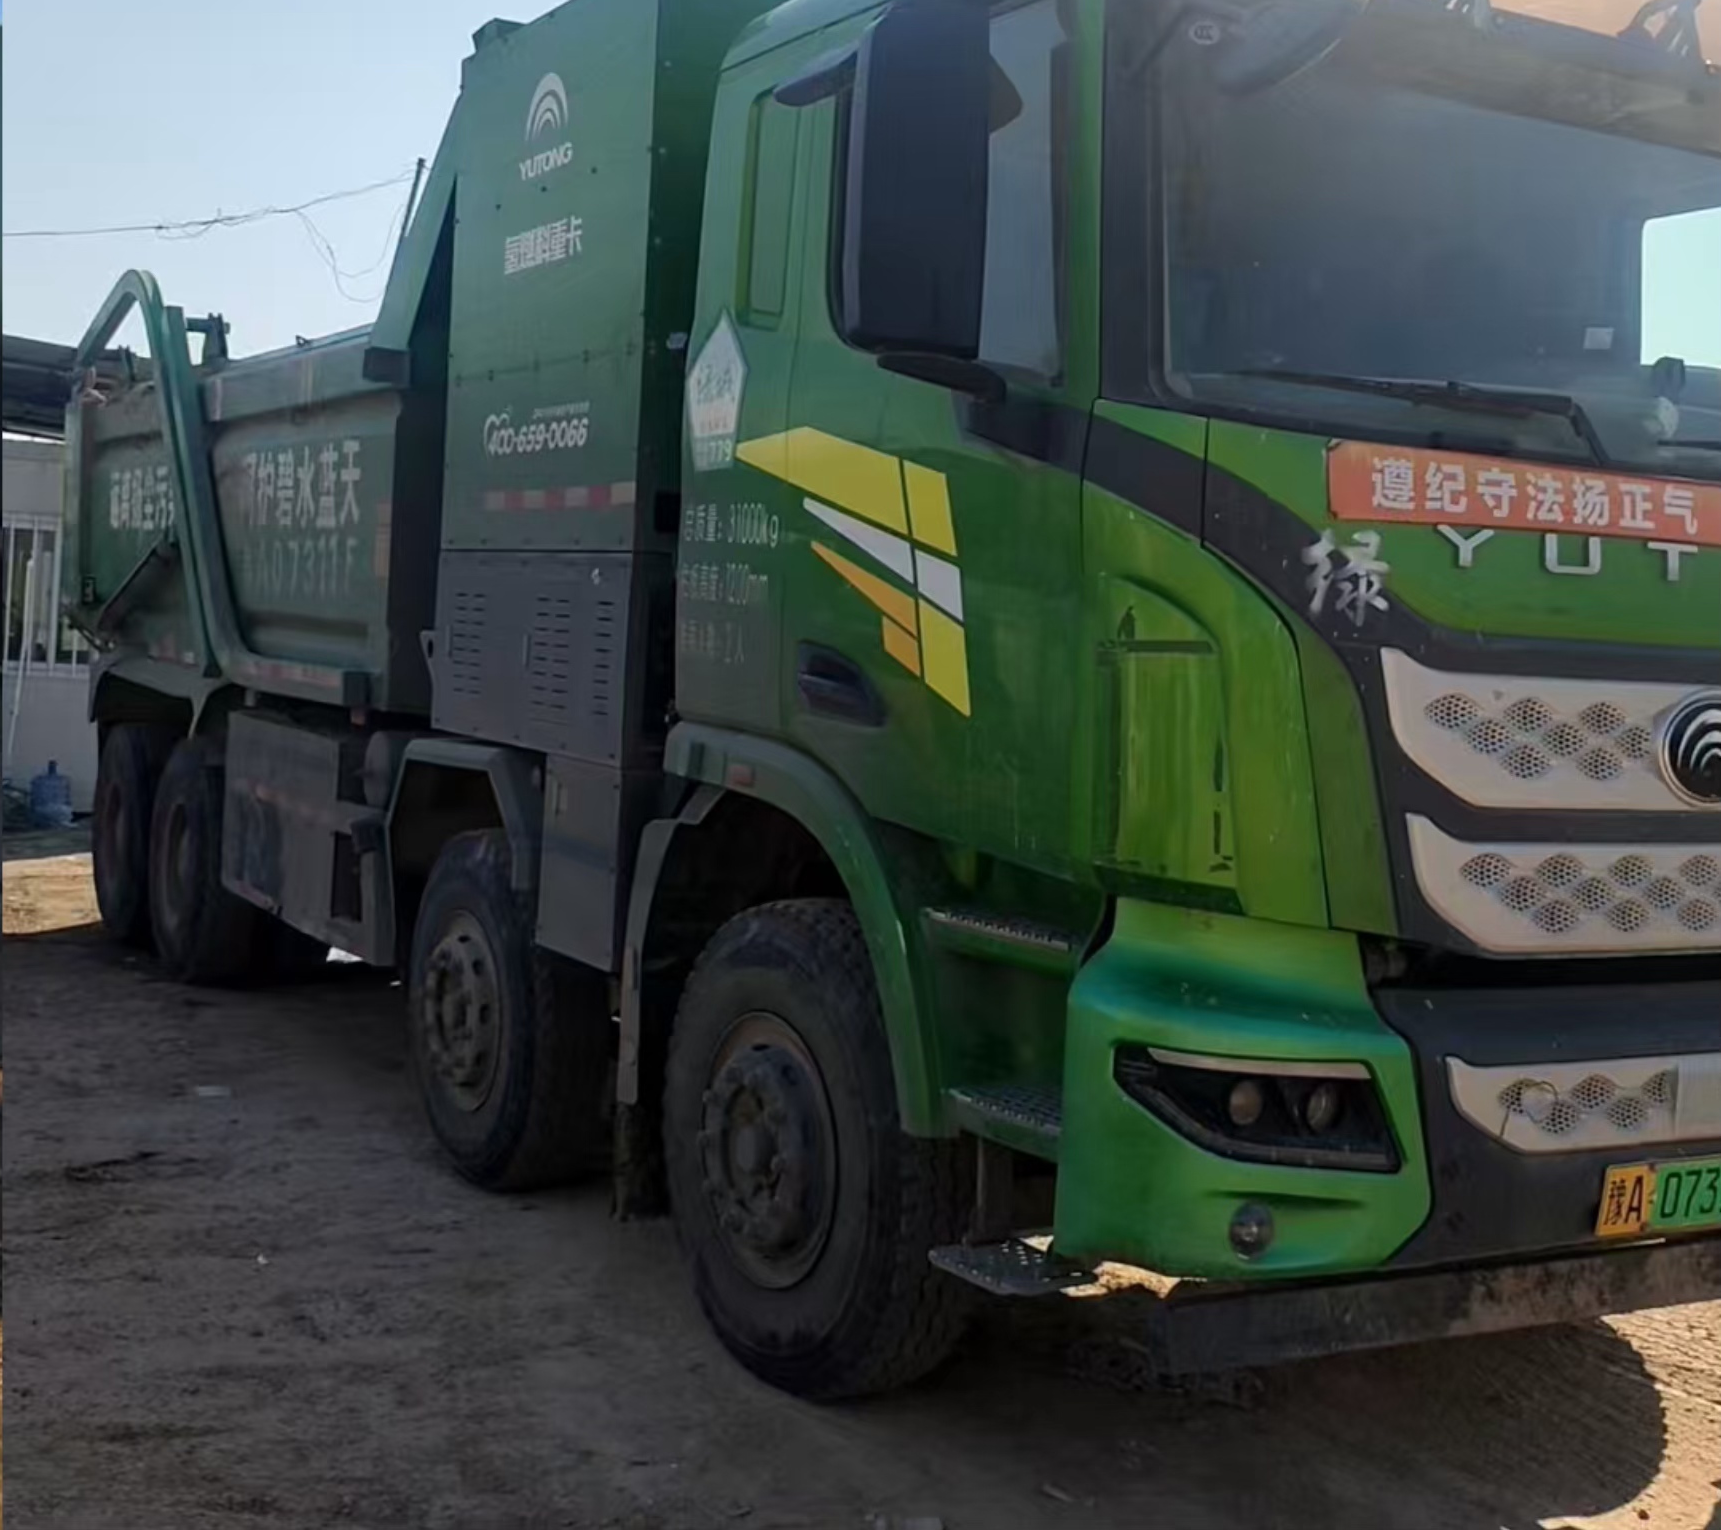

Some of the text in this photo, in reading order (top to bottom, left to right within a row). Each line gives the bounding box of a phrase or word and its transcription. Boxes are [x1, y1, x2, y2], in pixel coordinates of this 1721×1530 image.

[519, 141, 573, 181] YUTONG
[488, 417, 589, 456] 400-659-0066
[1371, 457, 1699, 536] 遵纪守法扬正气
